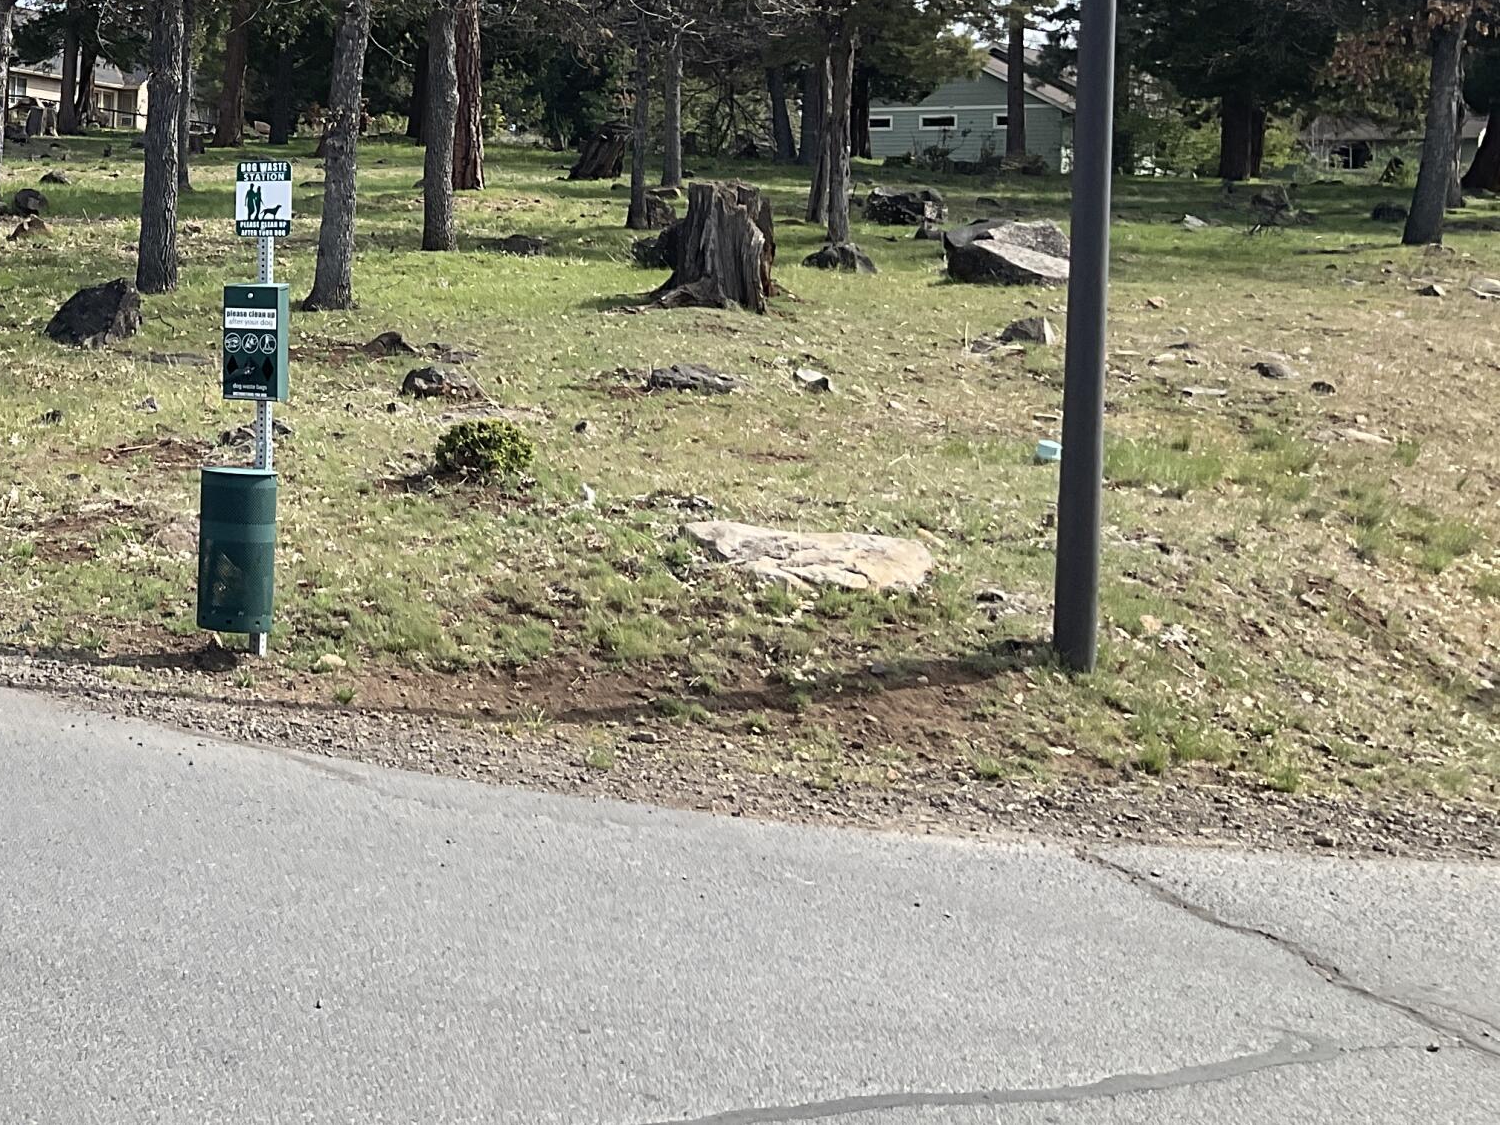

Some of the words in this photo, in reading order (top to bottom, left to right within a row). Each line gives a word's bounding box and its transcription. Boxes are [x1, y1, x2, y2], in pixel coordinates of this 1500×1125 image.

[240, 162, 258, 172] DOG
[260, 162, 288, 172] WASTE
[244, 173, 284, 181] STATION
